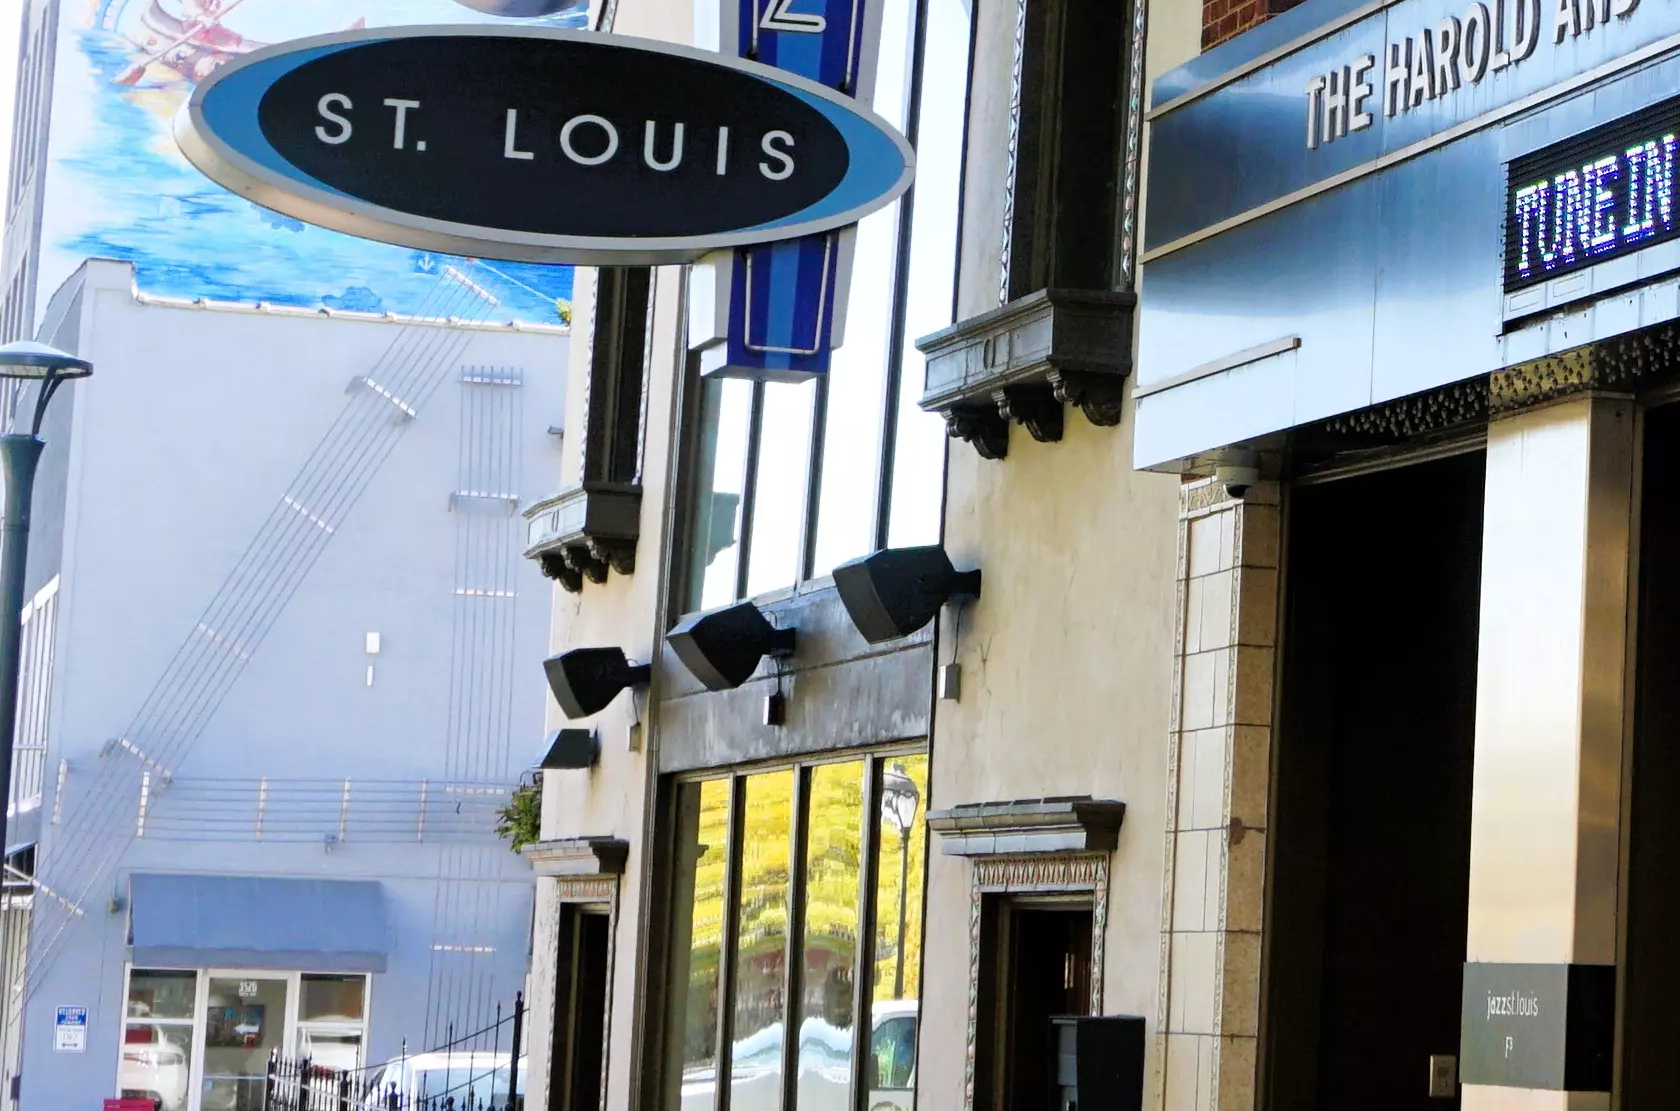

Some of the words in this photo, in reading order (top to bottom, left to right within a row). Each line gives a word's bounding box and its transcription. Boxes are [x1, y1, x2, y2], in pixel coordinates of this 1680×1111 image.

[314, 92, 428, 152] ST.
[502, 107, 797, 182] LOUIS
[1307, 54, 1376, 150] THE
